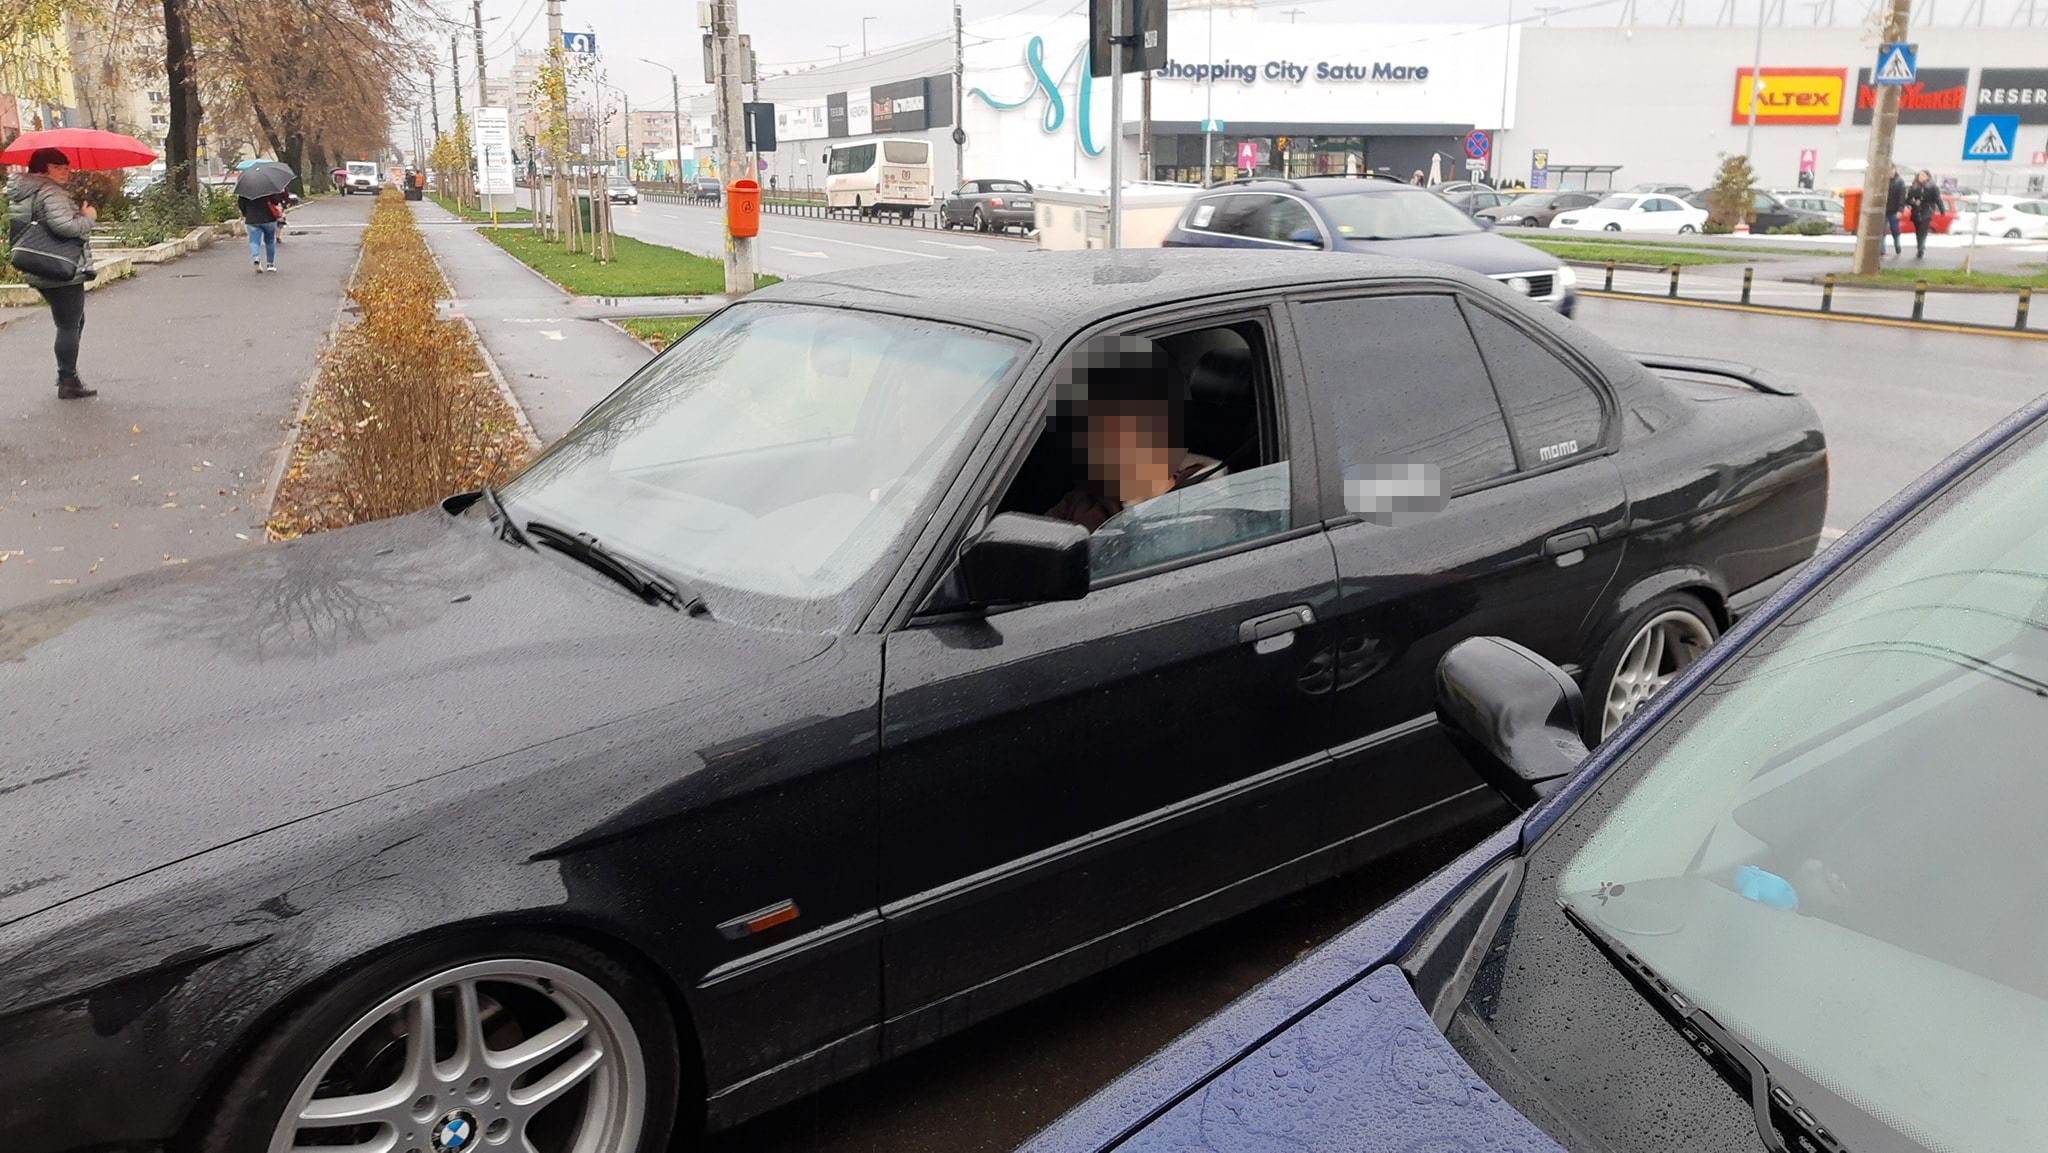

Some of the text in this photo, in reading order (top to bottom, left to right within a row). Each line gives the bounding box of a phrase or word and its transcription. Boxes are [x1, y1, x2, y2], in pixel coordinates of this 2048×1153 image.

[1264, 60, 1308, 83] City
[1316, 61, 1367, 80] Satu
[1371, 62, 1429, 80] Mare
[1207, 120, 1218, 132] A
[1242, 144, 1253, 157] A
